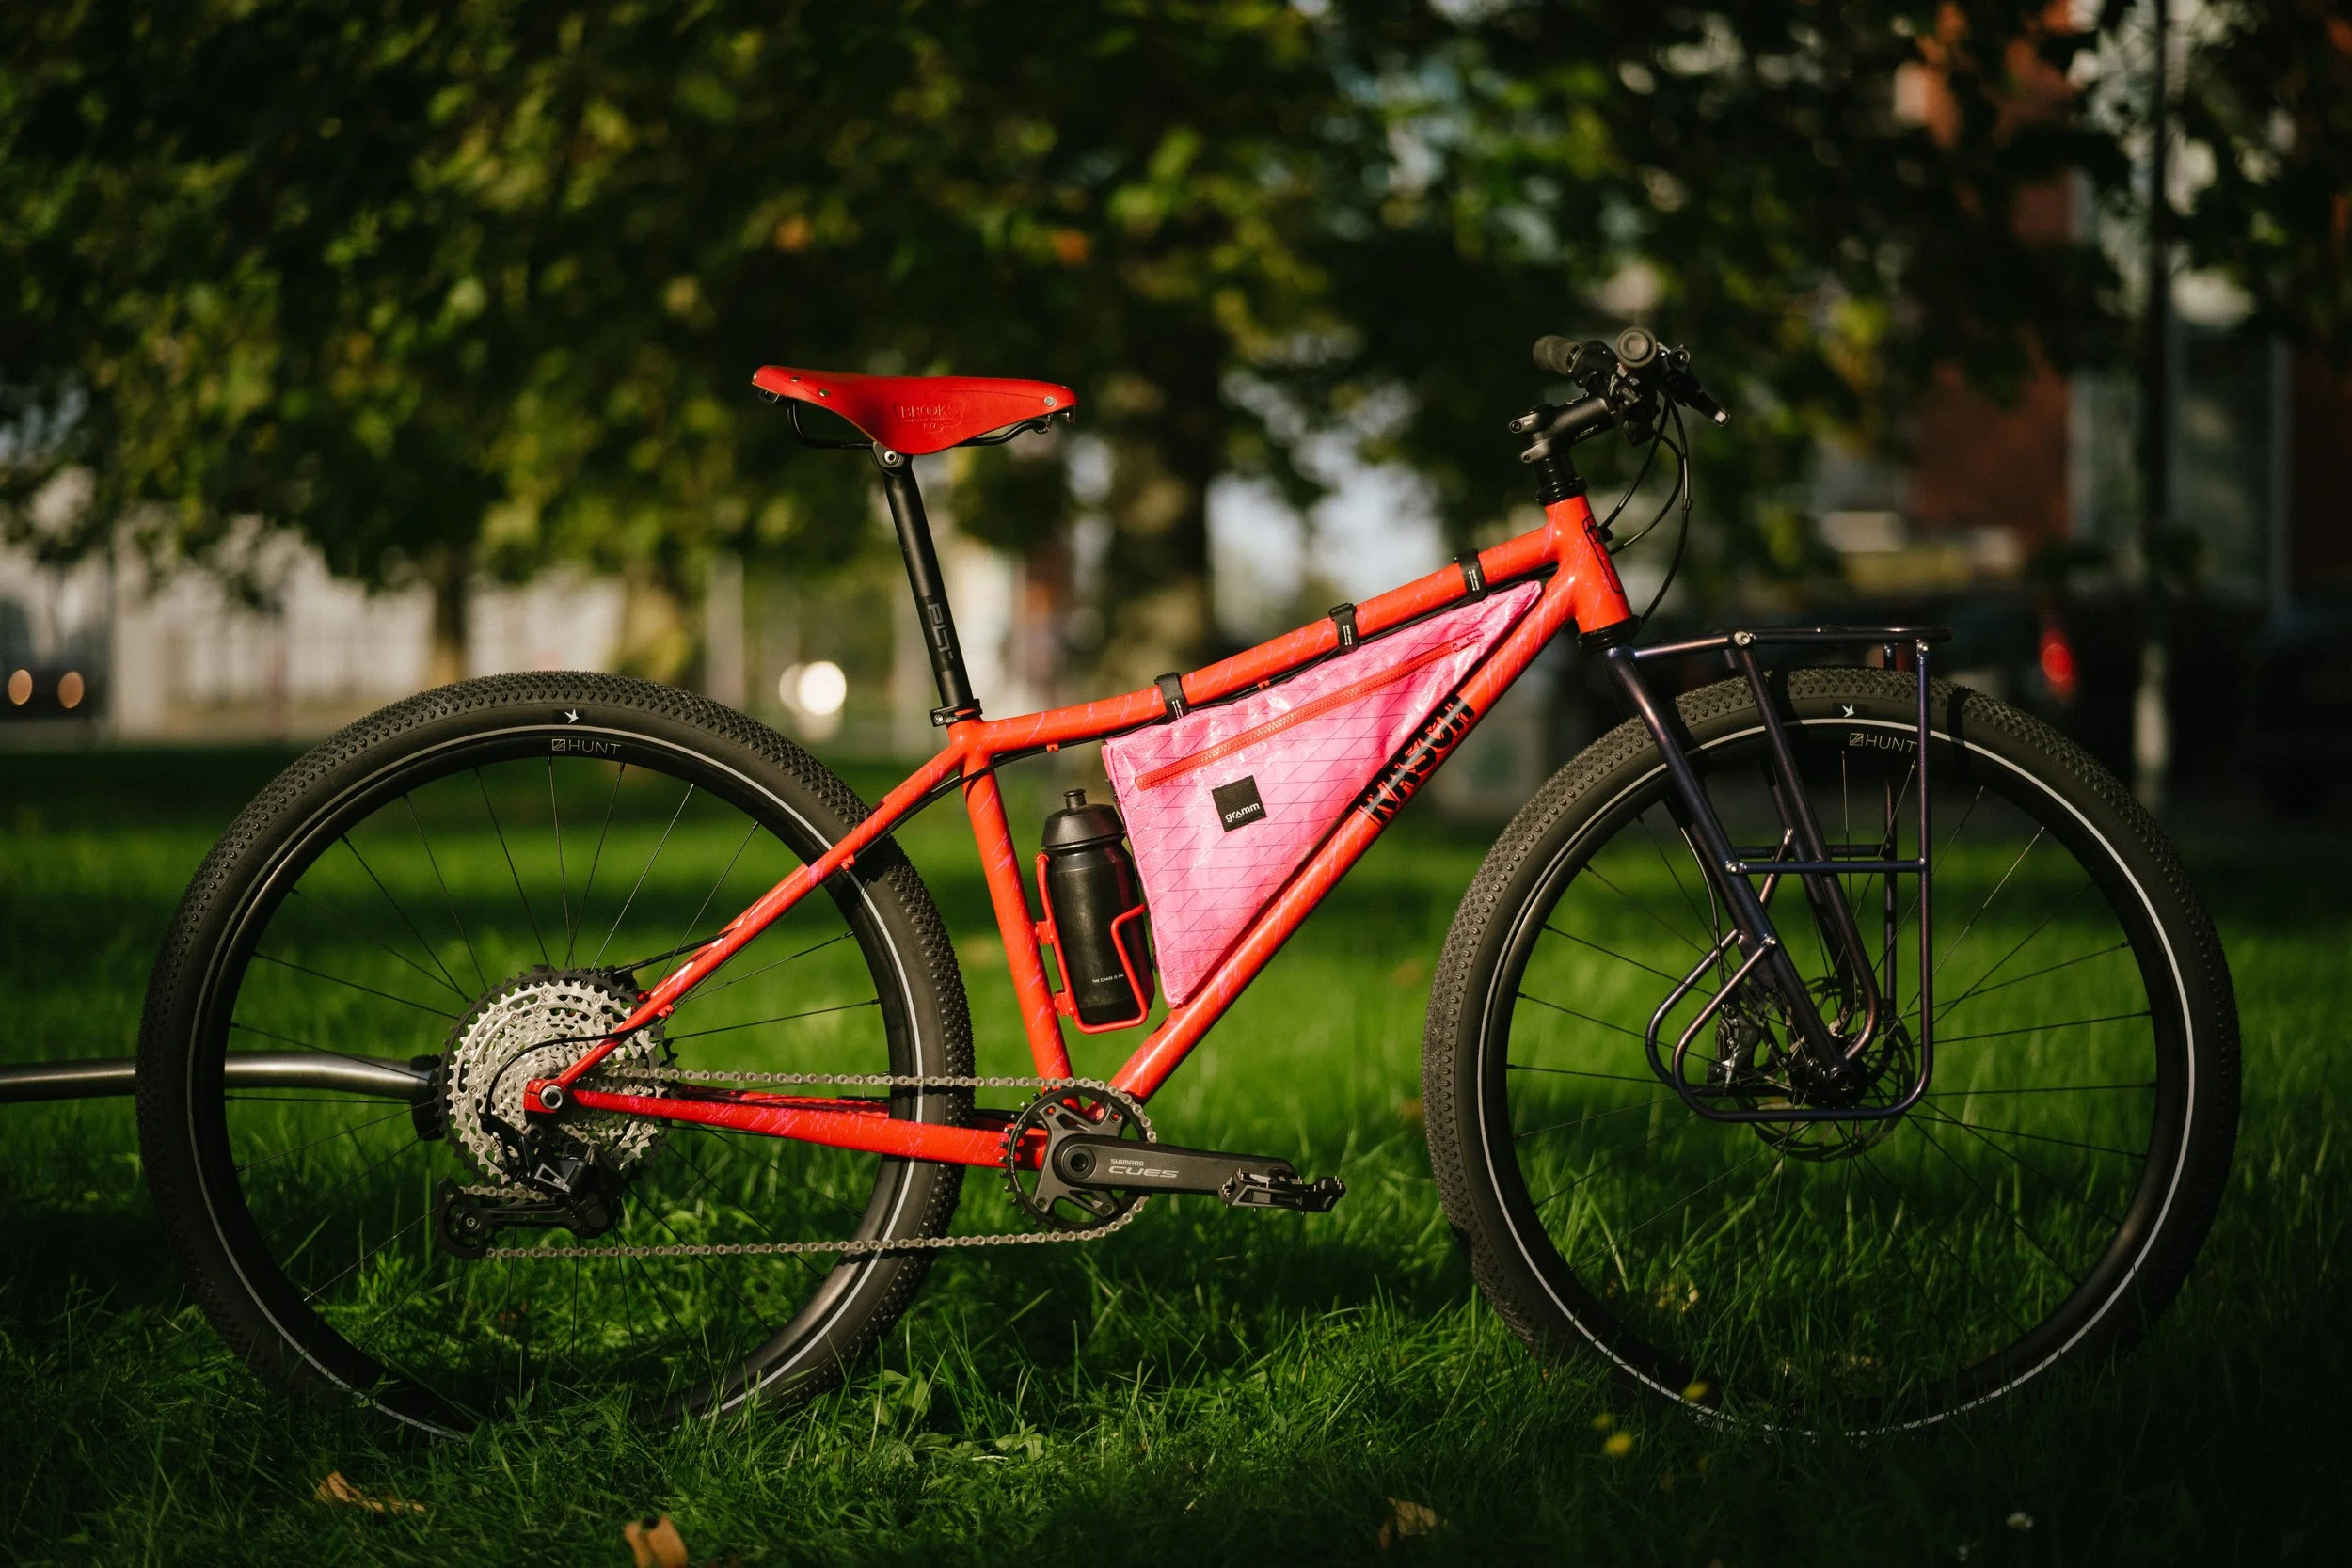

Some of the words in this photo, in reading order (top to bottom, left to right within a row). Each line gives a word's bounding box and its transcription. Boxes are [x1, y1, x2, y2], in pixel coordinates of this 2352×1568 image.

[901, 403, 959, 419] BROOKS
[568, 738, 621, 755] HUNT
[1865, 734, 1918, 753] HUNT
[1224, 802, 1261, 823] gramm
[1110, 1158, 1145, 1166] SHIMANO
[1108, 1165, 1180, 1179] CUES
